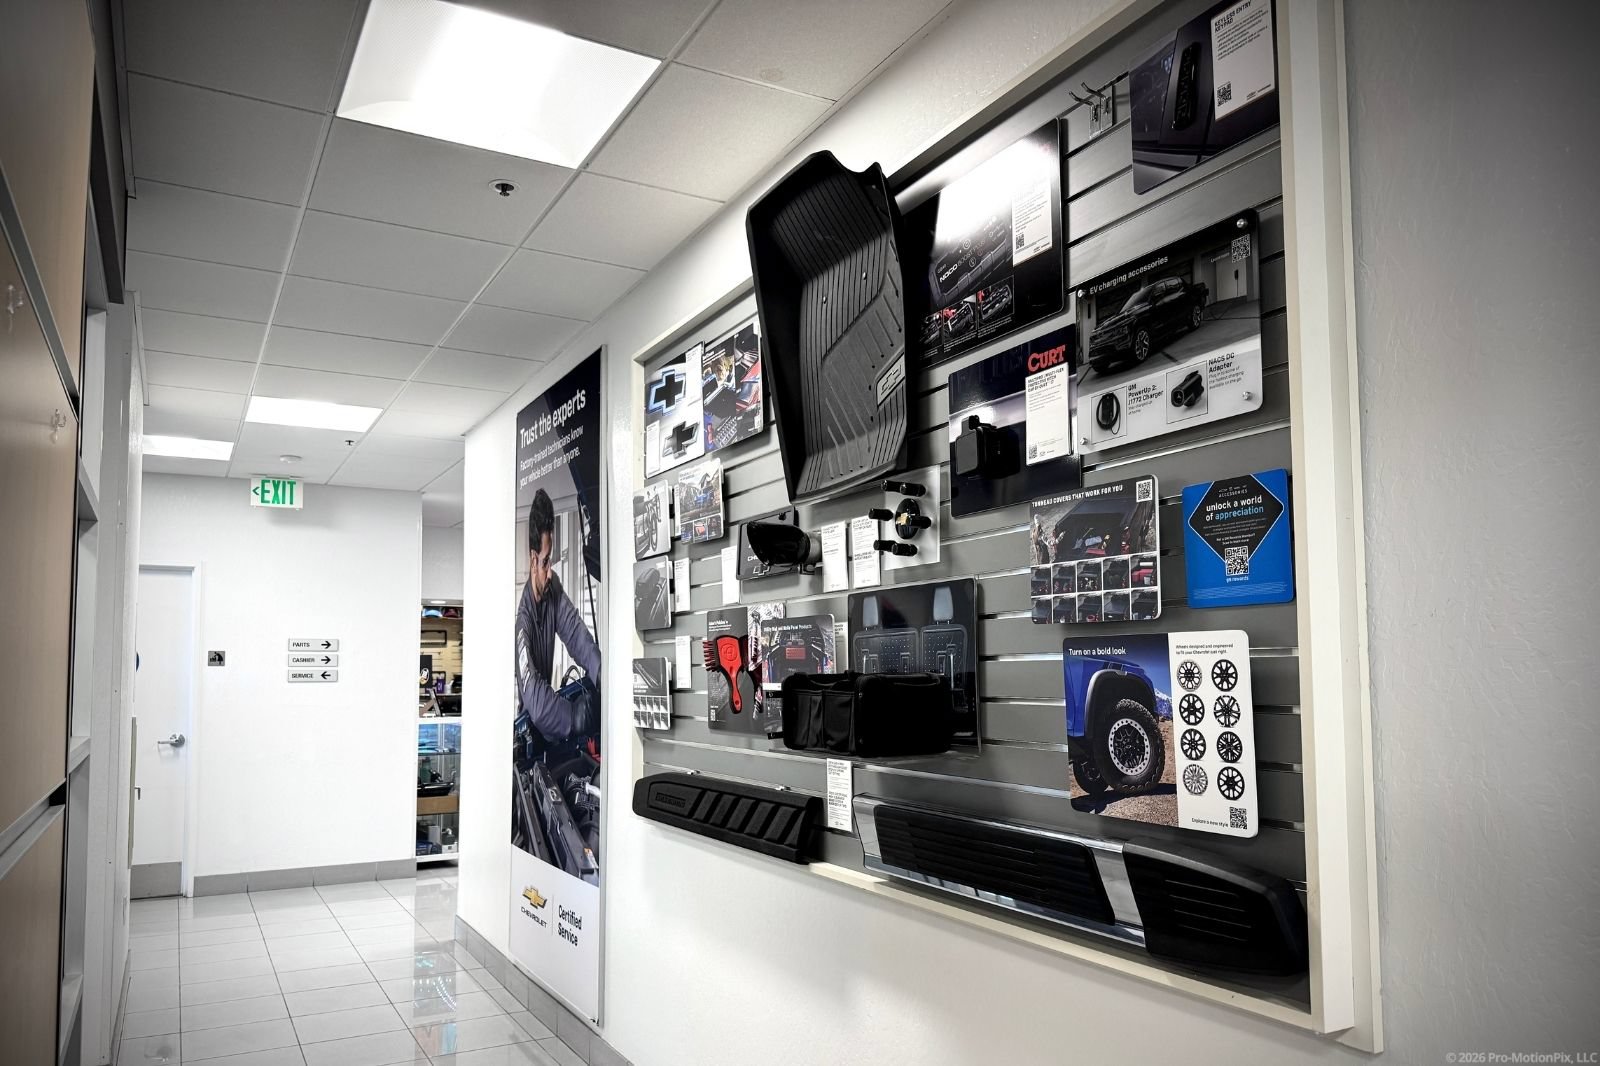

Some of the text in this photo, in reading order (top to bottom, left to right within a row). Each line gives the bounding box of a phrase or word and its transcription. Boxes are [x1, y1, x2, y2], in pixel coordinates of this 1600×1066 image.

[1214, 0, 1252, 26] KEYLESS ENTRY
[1214, 18, 1234, 33] KEYPAD
[940, 264, 958, 282] NOCO
[1089, 256, 1168, 294] EV charging accessories
[1028, 344, 1066, 372] CURT
[1208, 352, 1235, 366] NACS DC
[1208, 361, 1233, 374] Adapter
[1128, 387, 1152, 398] PowerUp
[1128, 396, 1142, 406] J1772
[1142, 390, 1164, 402] Charger
[520, 389, 586, 448] Trust the experts
[570, 425, 584, 441] know
[260, 480, 296, 505] EXIT
[1032, 484, 1124, 508] TONNEAU COVERS THAT WORK FOR YOU
[1218, 488, 1248, 498] ACCESSORIES
[1206, 500, 1232, 512] unlock
[1239, 494, 1262, 506] world
[1205, 506, 1264, 522] of appreciation
[1097, 647, 1111, 655] bold
[1112, 646, 1126, 655] look
[520, 906, 547, 928] CHEVROLET
[558, 904, 582, 930] Certified
[558, 922, 578, 946] Service
